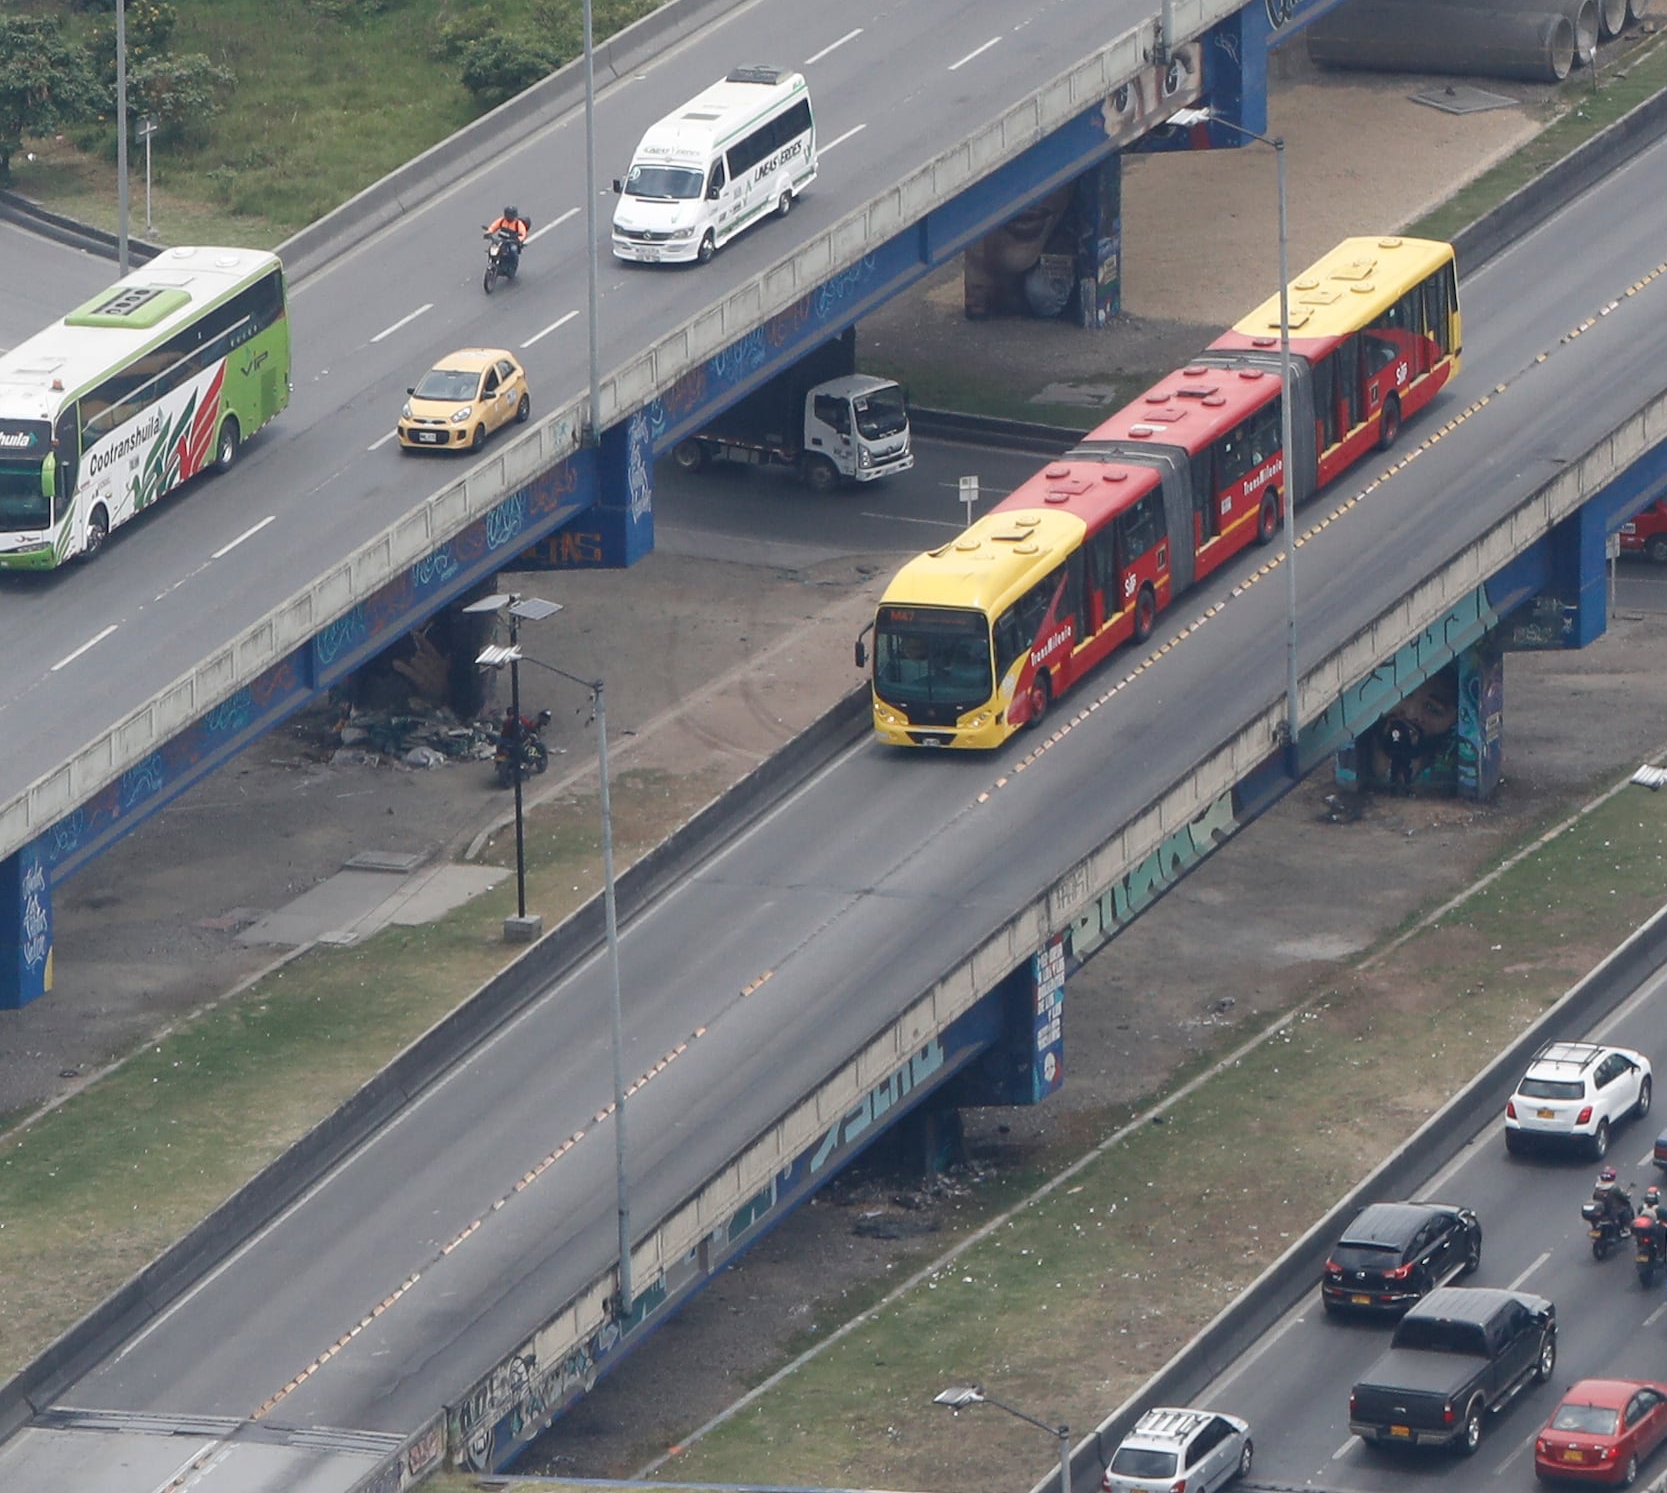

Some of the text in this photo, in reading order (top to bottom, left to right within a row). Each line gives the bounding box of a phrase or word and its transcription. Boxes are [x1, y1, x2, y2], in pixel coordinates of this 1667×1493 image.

[754, 158, 778, 182] LINEAS
[89, 416, 161, 477] Cootranshuila
[1243, 459, 1283, 496] TransMilenio
[1030, 624, 1072, 667] TransMilenio
